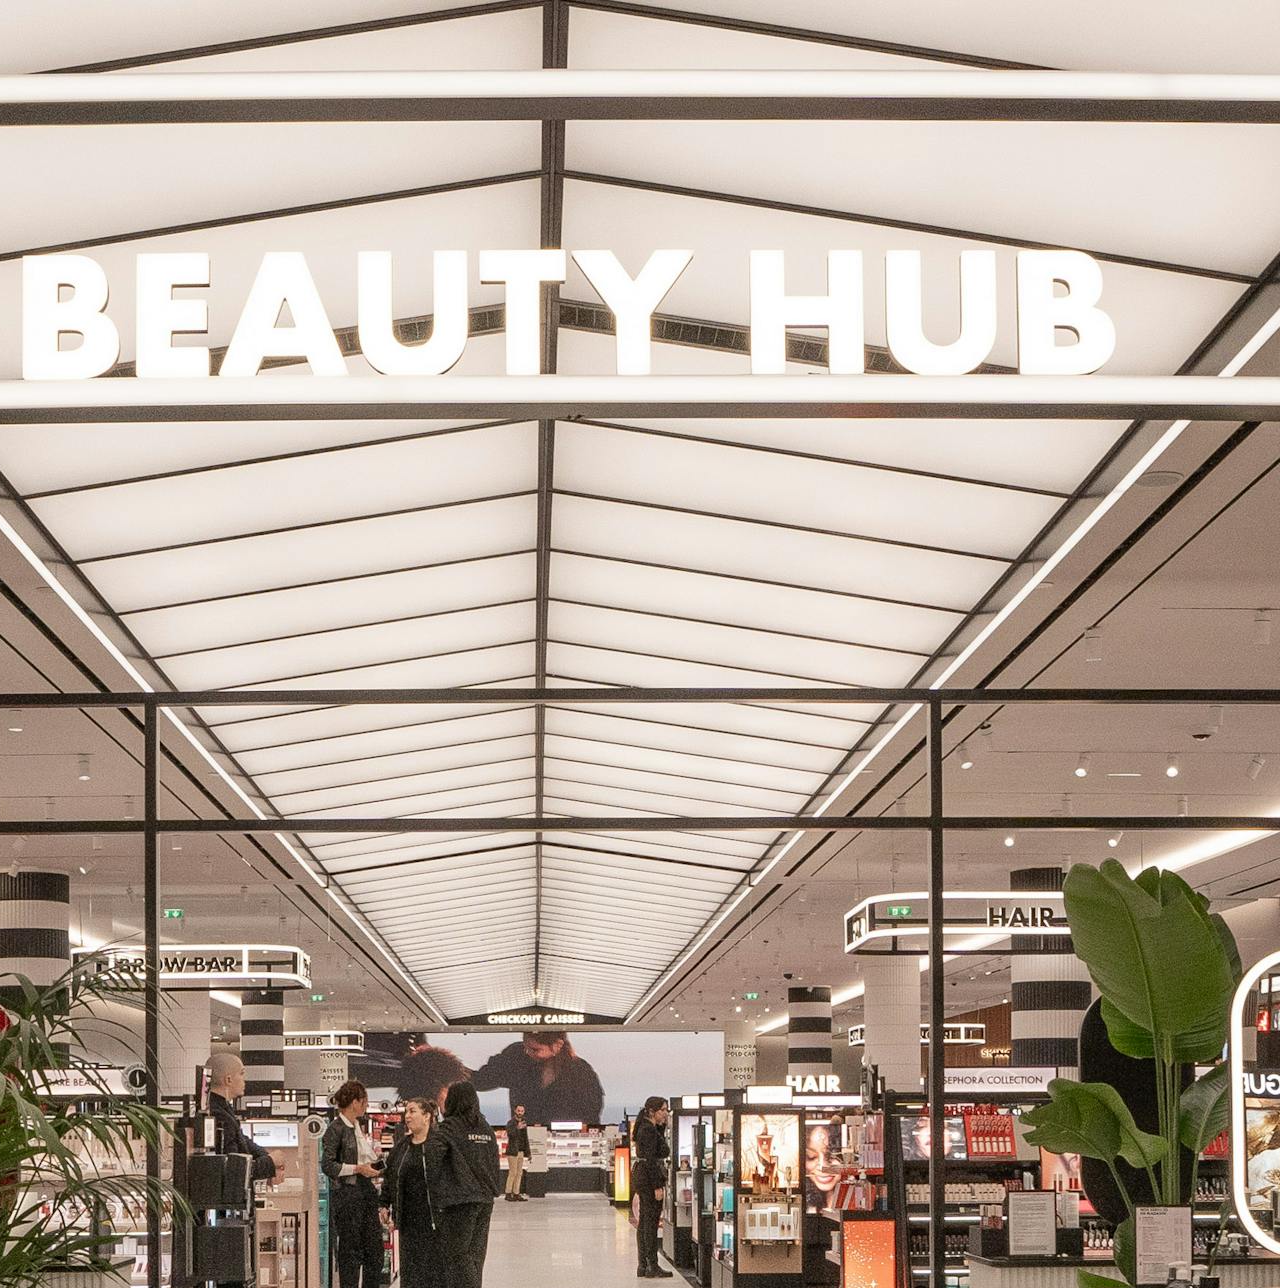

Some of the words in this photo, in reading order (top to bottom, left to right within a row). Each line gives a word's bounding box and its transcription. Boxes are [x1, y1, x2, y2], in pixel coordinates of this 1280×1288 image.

[21, 249, 694, 379] BEAUTY
[749, 249, 1116, 378] HUB
[987, 906, 1055, 928] HAIR
[194, 957, 237, 973] BAR
[487, 1014, 542, 1025] CHECKOUT
[544, 1014, 585, 1025] CAISSES
[284, 1037, 297, 1047] FT
[299, 1037, 324, 1047] HUB
[785, 1074, 841, 1093] HAIR
[943, 1075, 984, 1085] SEPHORA
[986, 1075, 1044, 1085] COLLECTION
